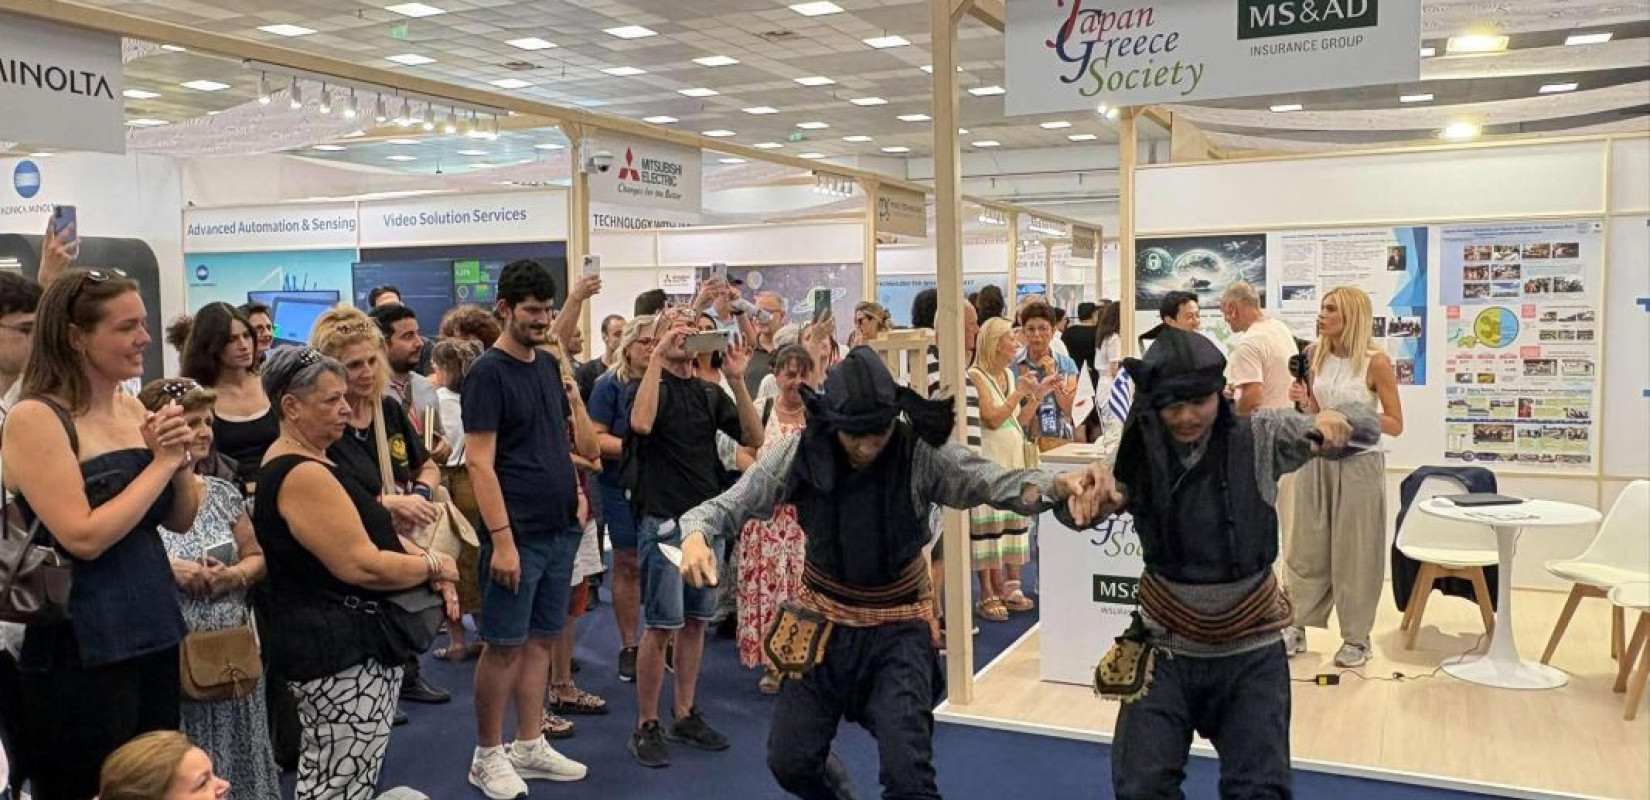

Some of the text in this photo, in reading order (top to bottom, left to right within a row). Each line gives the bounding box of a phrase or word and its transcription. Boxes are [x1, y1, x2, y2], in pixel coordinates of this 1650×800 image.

[1046, 0, 1155, 48] Japan
[1249, 0, 1368, 29] MS&AD
[1056, 10, 1179, 83] Greece
[1250, 35, 1364, 57] INSURANCE GROUP
[1079, 57, 1203, 96] Society
[641, 157, 682, 176] MITSUBISHI
[641, 172, 678, 187] ELECTRIC
[187, 216, 356, 237] Advanced Automation & Sensing
[383, 207, 527, 227] Video Solution Services
[593, 213, 652, 230] TECHNOLOGY
